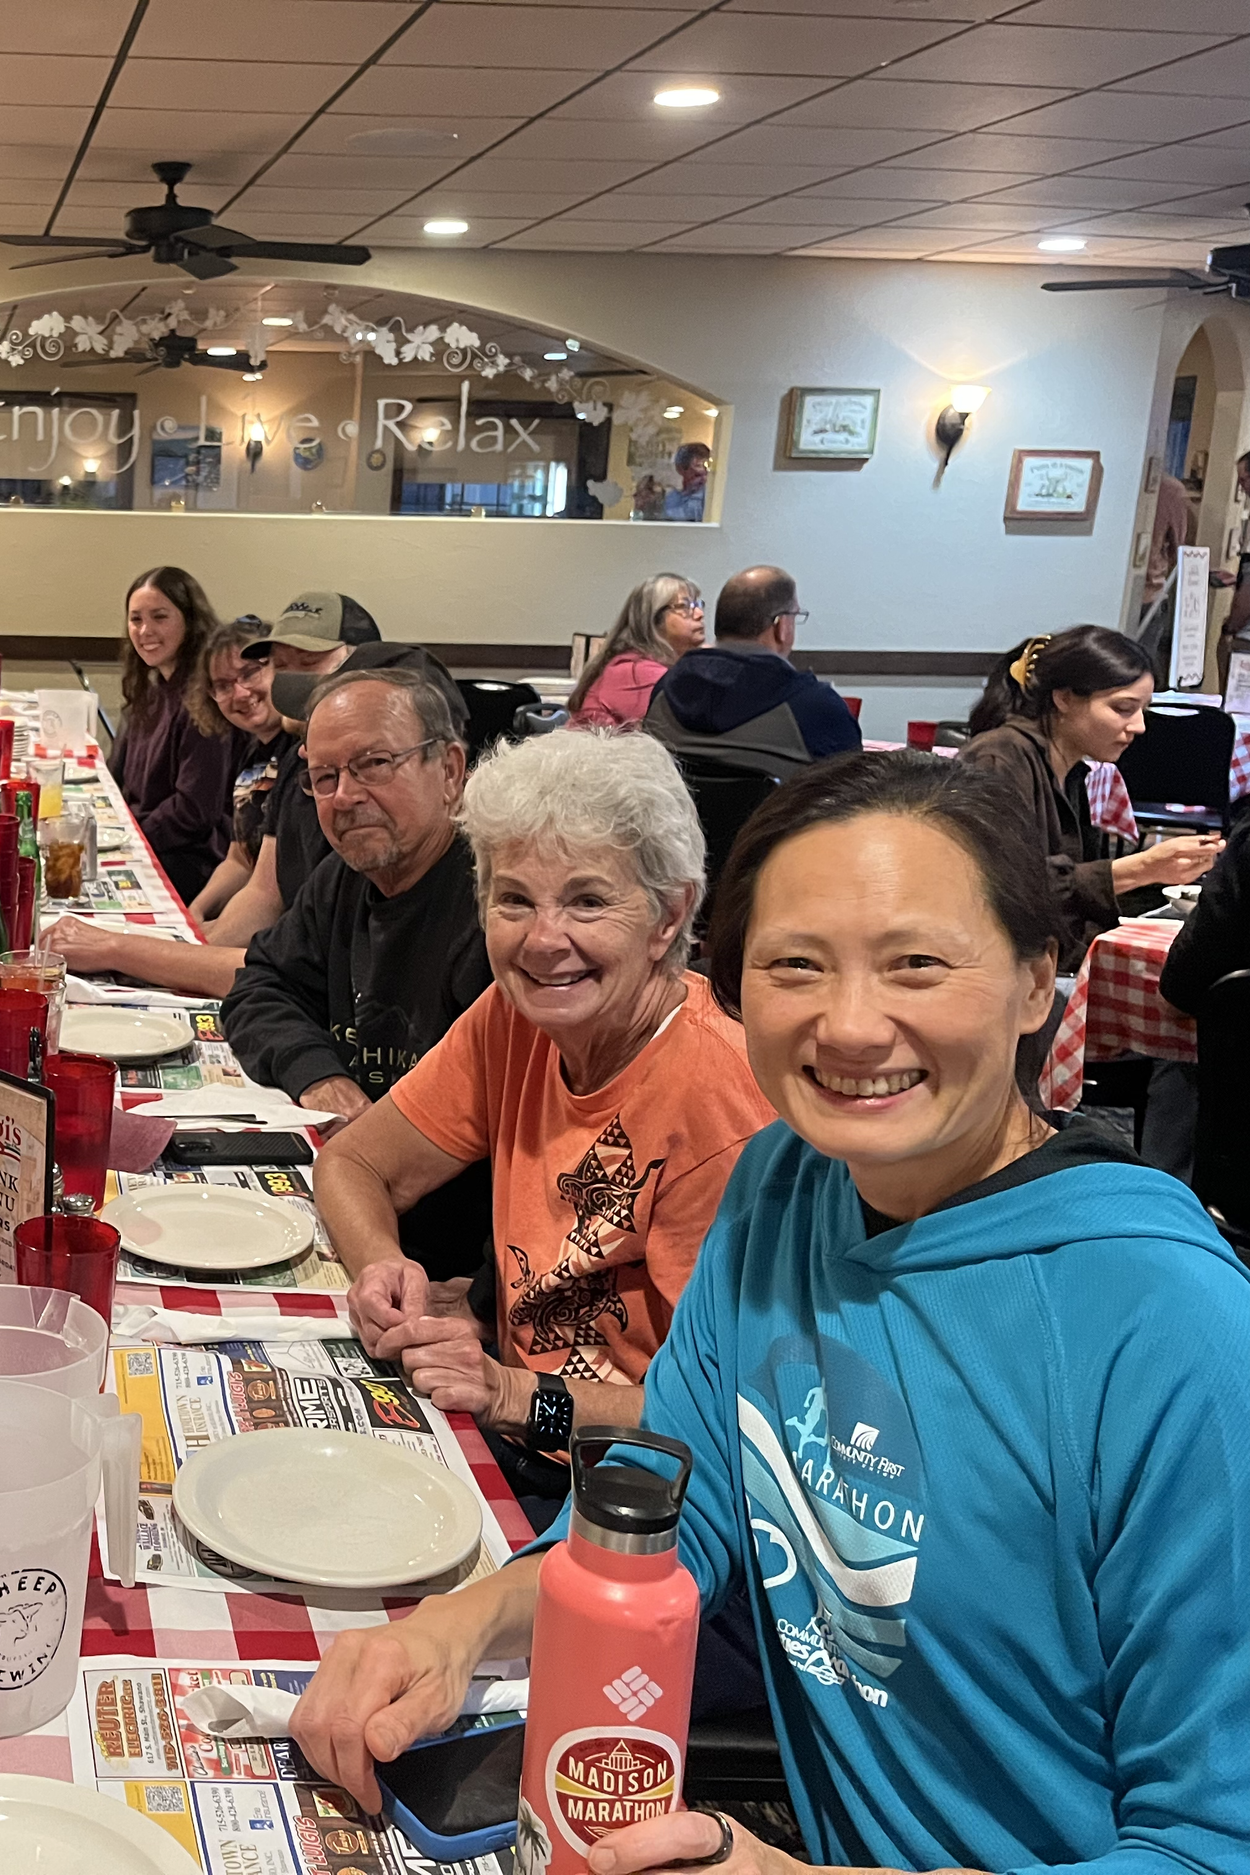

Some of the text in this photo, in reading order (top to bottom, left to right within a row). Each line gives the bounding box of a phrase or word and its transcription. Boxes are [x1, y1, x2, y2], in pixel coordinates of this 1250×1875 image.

[188, 393, 321, 449] Live
[373, 380, 544, 457] Relax
[227, 1370, 248, 1410] LUIGI'S
[293, 1377, 329, 1430] RIME
[317, 1379, 341, 1431] ERSPORTS
[175, 1394, 194, 1434] HOMETOWN
[189, 1397, 208, 1434] INSURANCE
[830, 1435, 879, 1467] COMMUNITY
[878, 1456, 906, 1478] FIRST
[138, 1522, 151, 1551] WALLACE
[150, 1522, 163, 1552] FLOORING
[135, 1682, 147, 1714] Shawano
[95, 1679, 125, 1759] REUTER
[120, 1695, 144, 1759] ELECTRIC
[141, 1726, 152, 1743] Main
[151, 1672, 179, 1772] 715-526-3811
[145, 1743, 152, 1752] S.
[145, 1751, 155, 1764] 617
[217, 1745, 229, 1768] Serving
[567, 1754, 669, 1795] MADISON
[211, 1786, 228, 1832] 715-526-6390
[223, 1786, 243, 1832] 800-428-6390
[252, 1806, 263, 1819] Erie
[567, 1797, 666, 1823] MARATHON
[218, 1839, 240, 1875] TOWN
[292, 1815, 325, 1866] LUIGI'S
